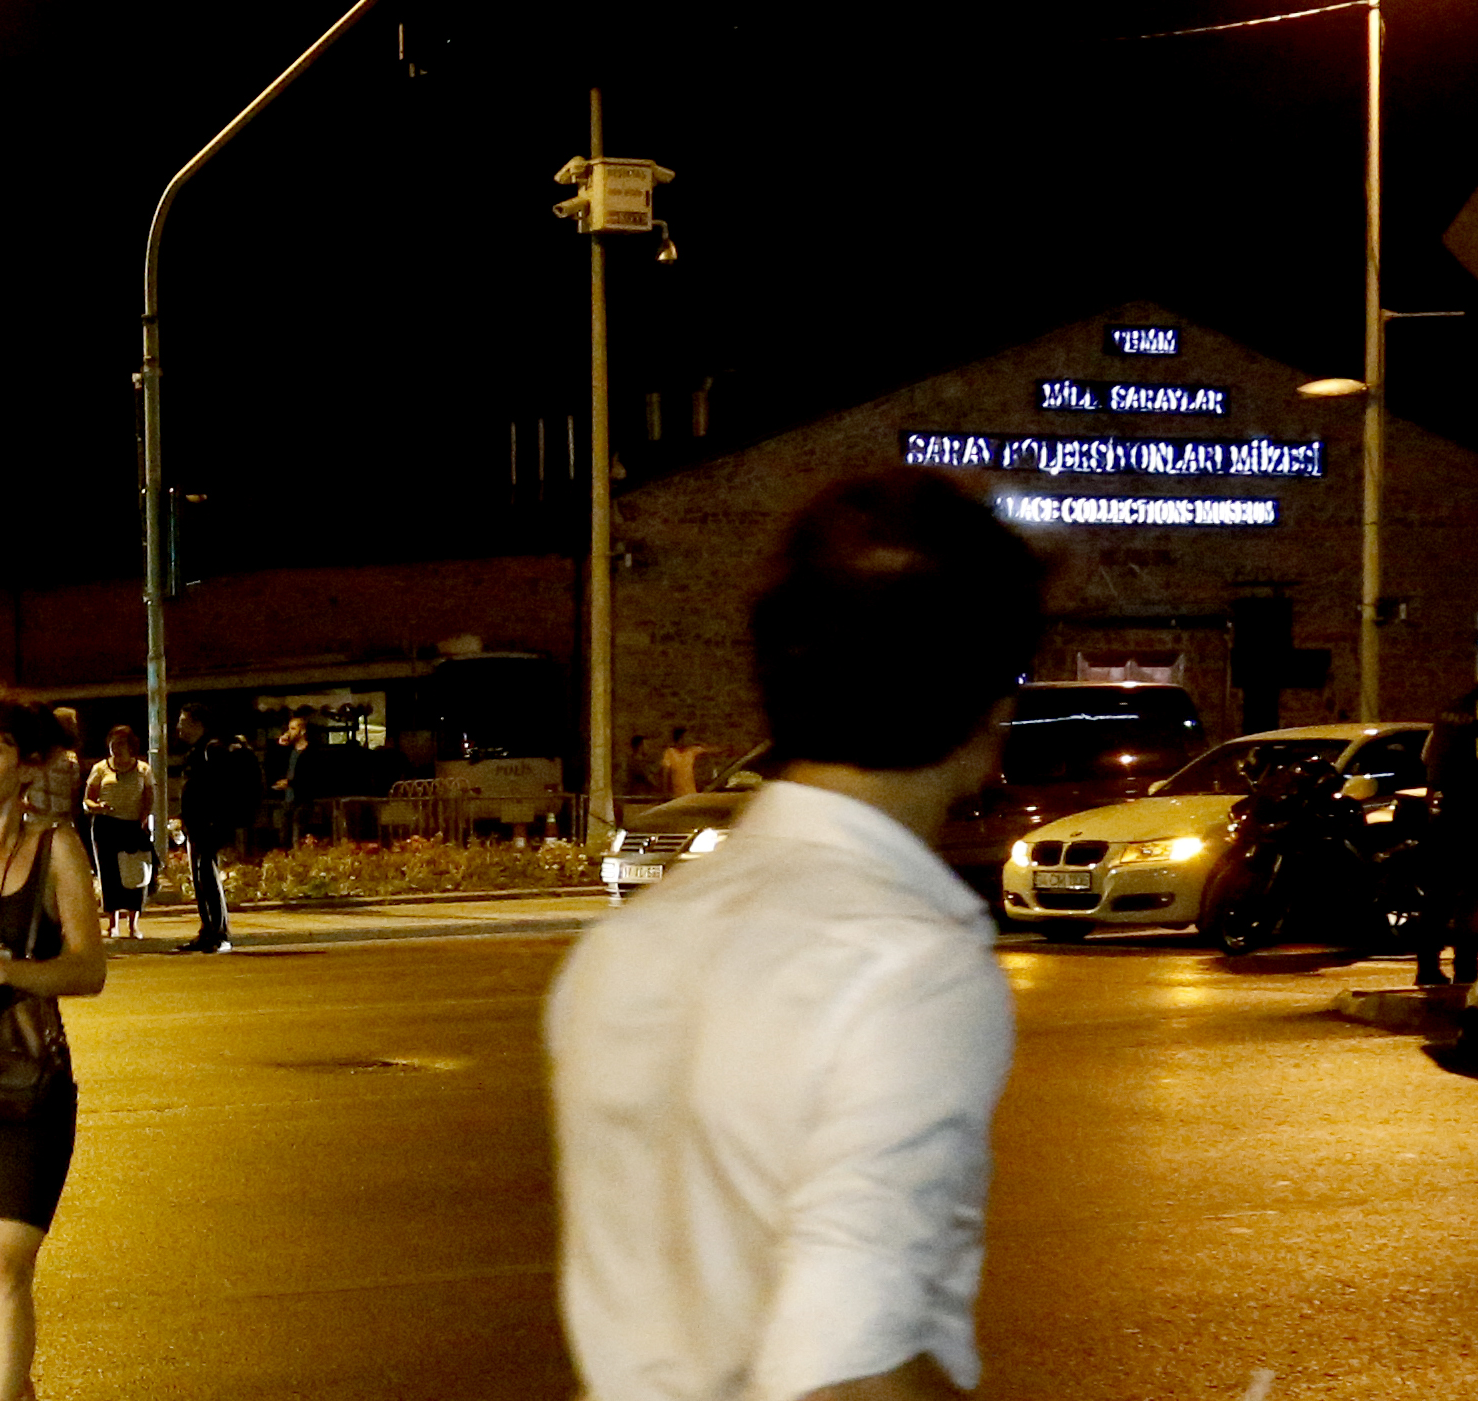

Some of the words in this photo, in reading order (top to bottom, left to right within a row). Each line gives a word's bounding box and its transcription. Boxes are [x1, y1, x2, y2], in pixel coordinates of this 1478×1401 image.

[1110, 385, 1225, 414] SARAYLAR
[1061, 498, 1193, 524] COLLECTIONS
[1194, 500, 1276, 524] MUSEUM
